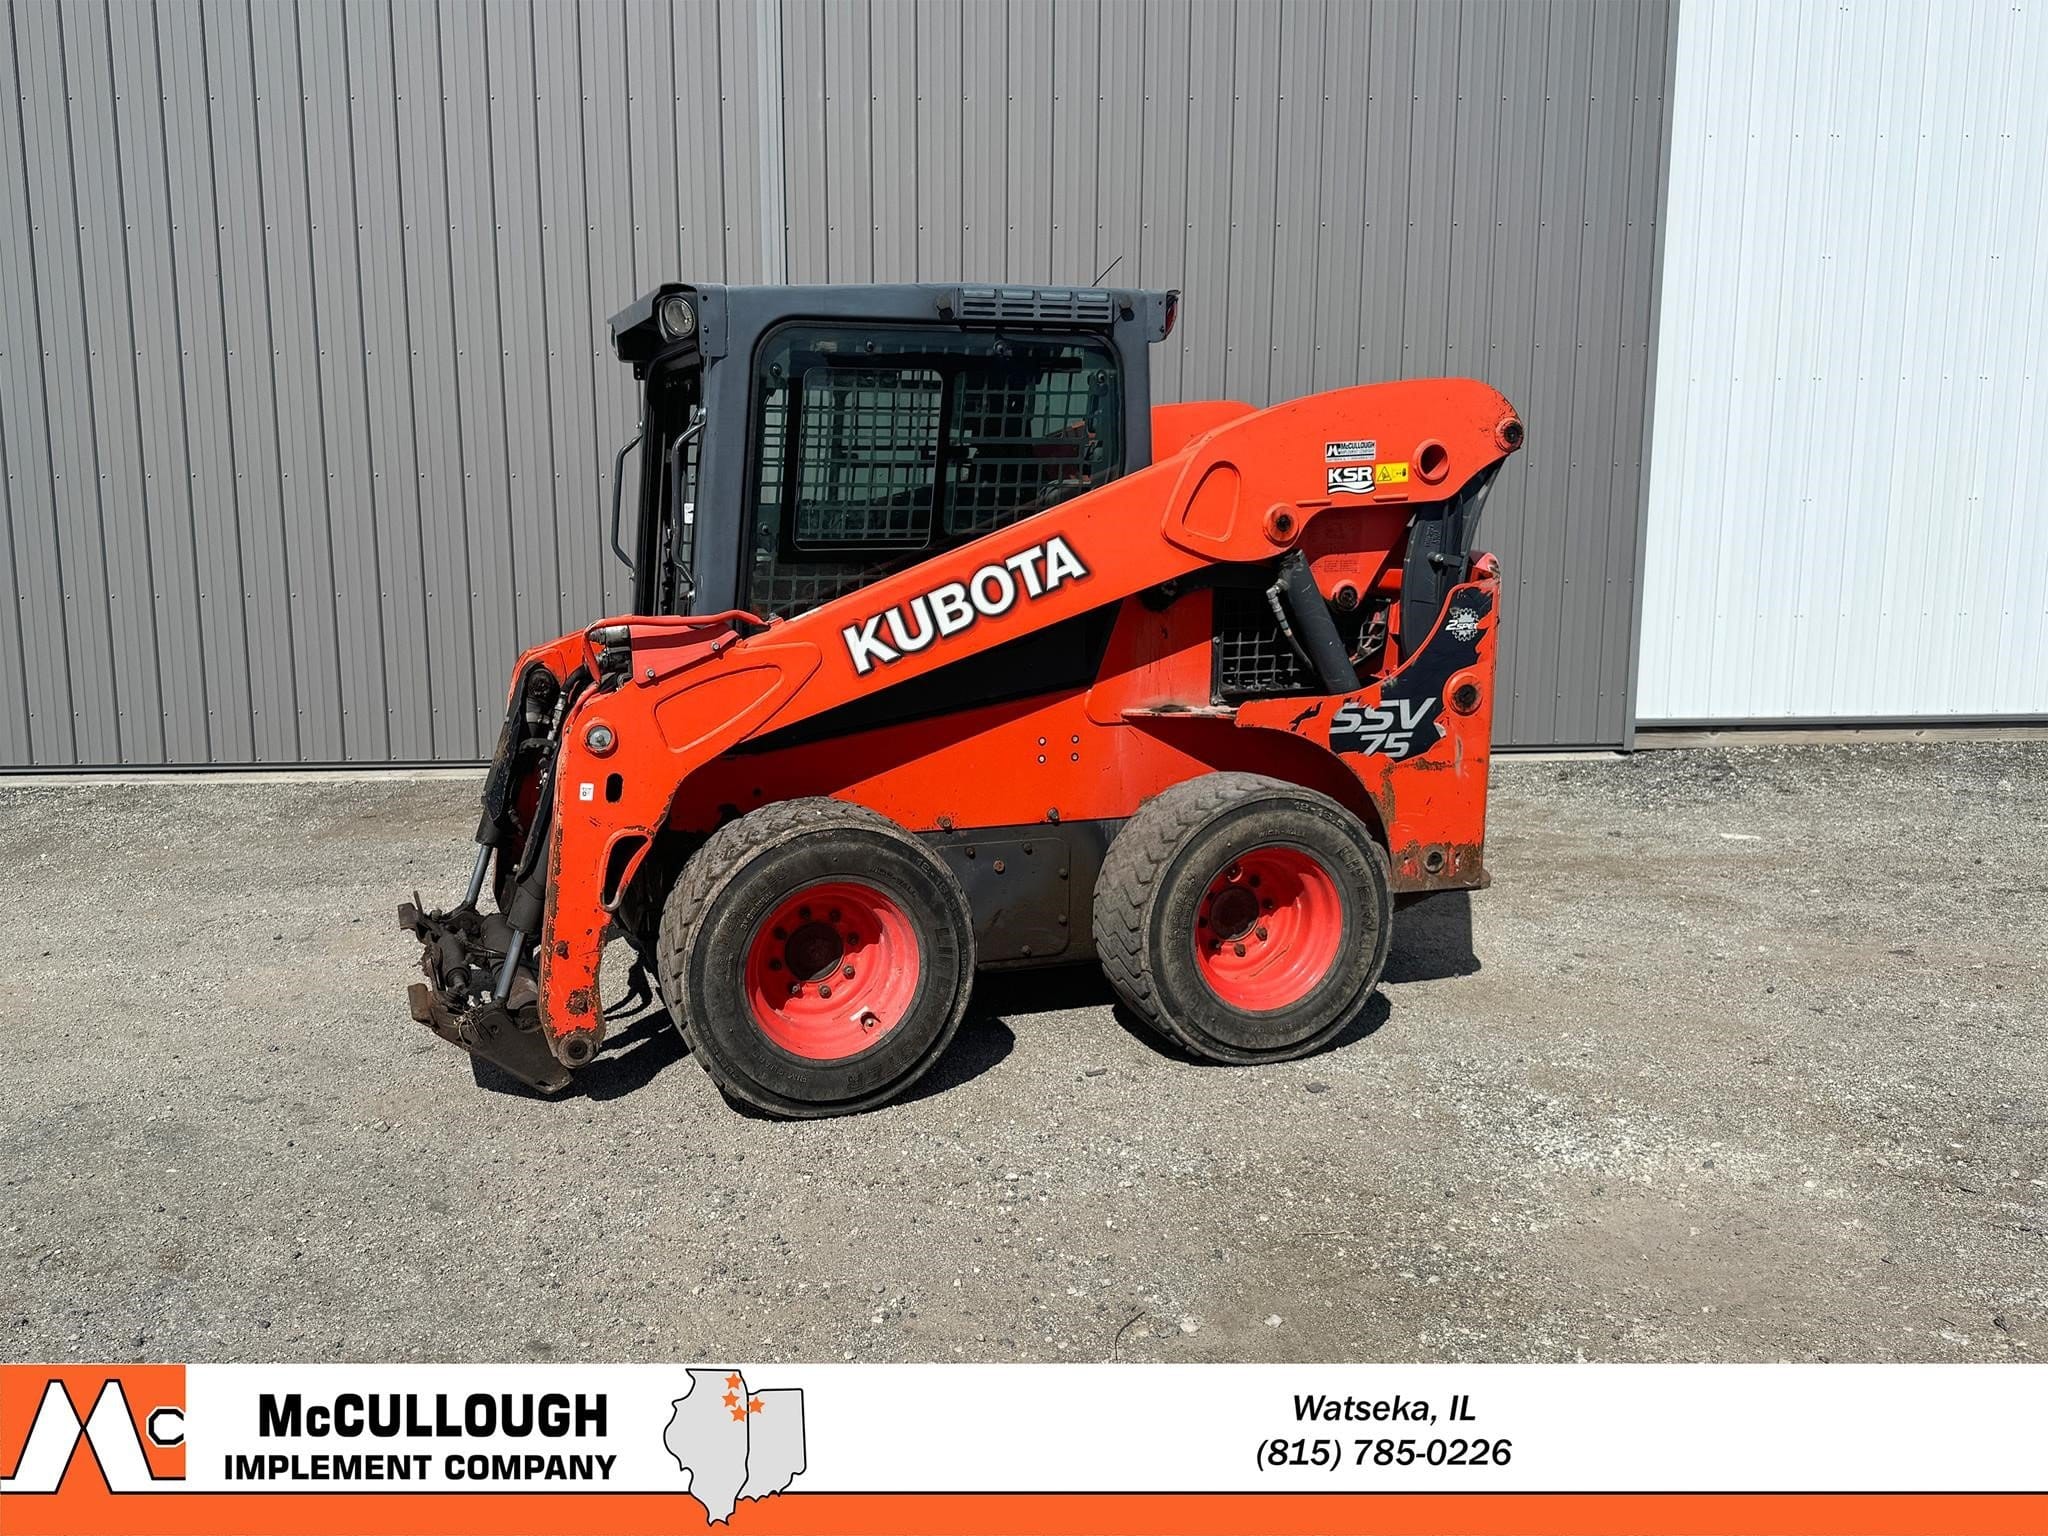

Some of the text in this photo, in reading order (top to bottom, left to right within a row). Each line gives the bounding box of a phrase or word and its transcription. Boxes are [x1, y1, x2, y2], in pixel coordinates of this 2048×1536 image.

[1328, 467, 1373, 483] KSR
[841, 535, 1089, 675] KUBOTA
[1329, 697, 1437, 735] SSV
[1360, 731, 1413, 758] 75
